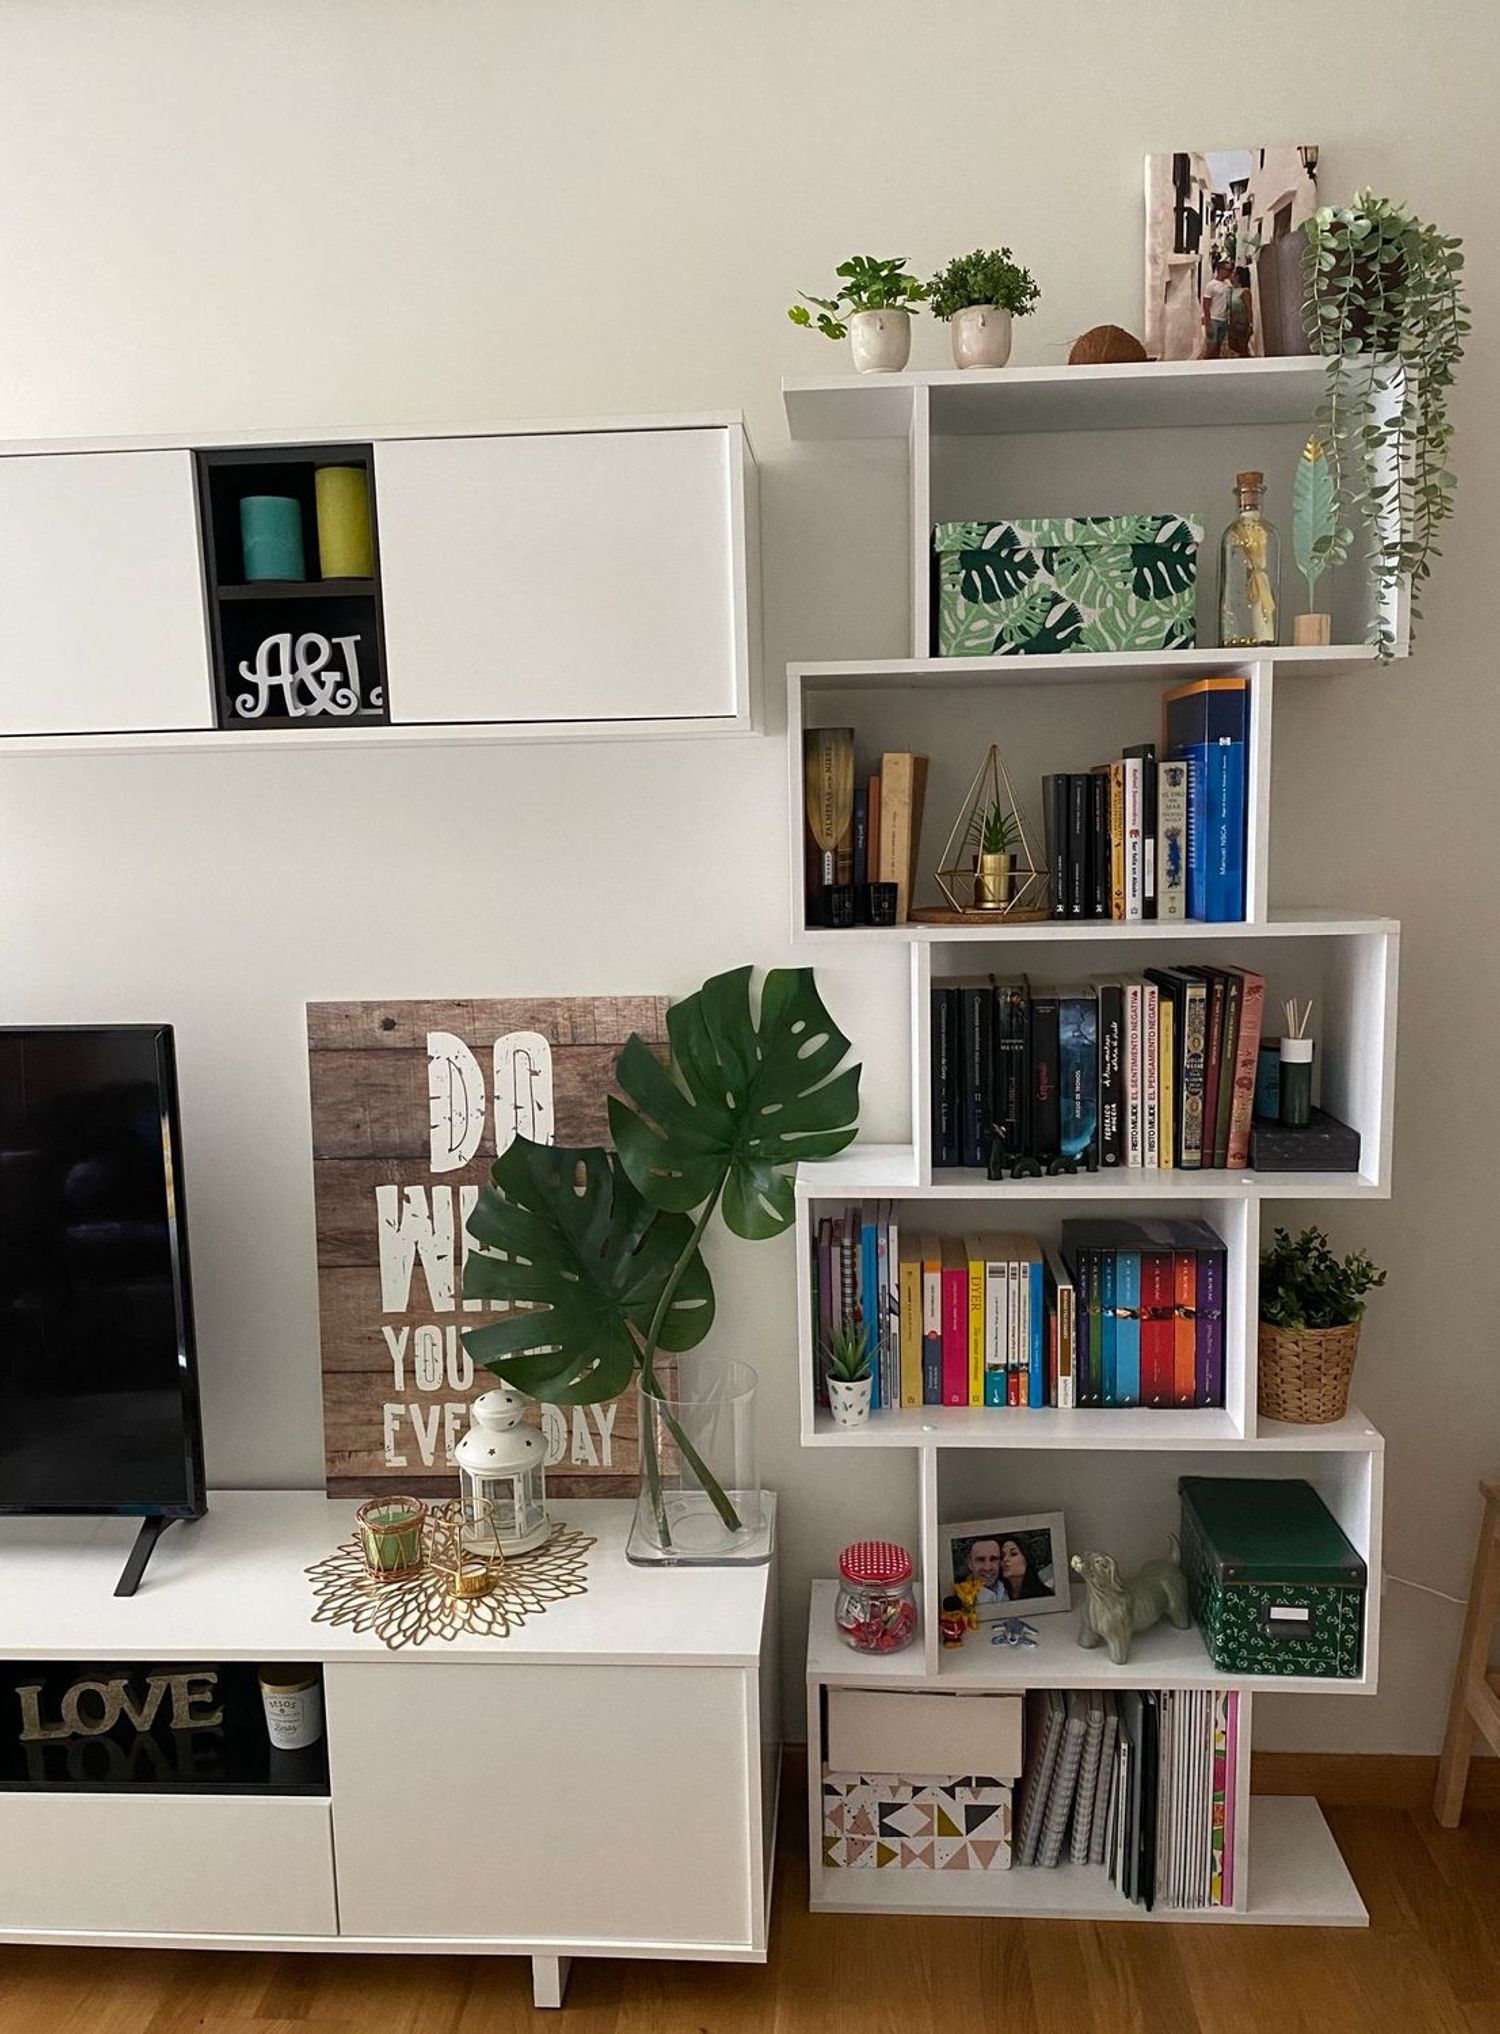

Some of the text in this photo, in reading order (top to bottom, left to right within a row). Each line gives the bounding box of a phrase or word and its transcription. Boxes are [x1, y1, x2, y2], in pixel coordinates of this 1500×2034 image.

[427, 1031, 555, 1173] DO
[1131, 1090, 1138, 1101] EL
[1148, 1090, 1155, 1101] EL
[971, 1276, 982, 1312] DYER
[381, 1325, 475, 1391] YOU
[383, 1403, 617, 1467] EVEDAY
[15, 1672, 224, 1741] LOVE
